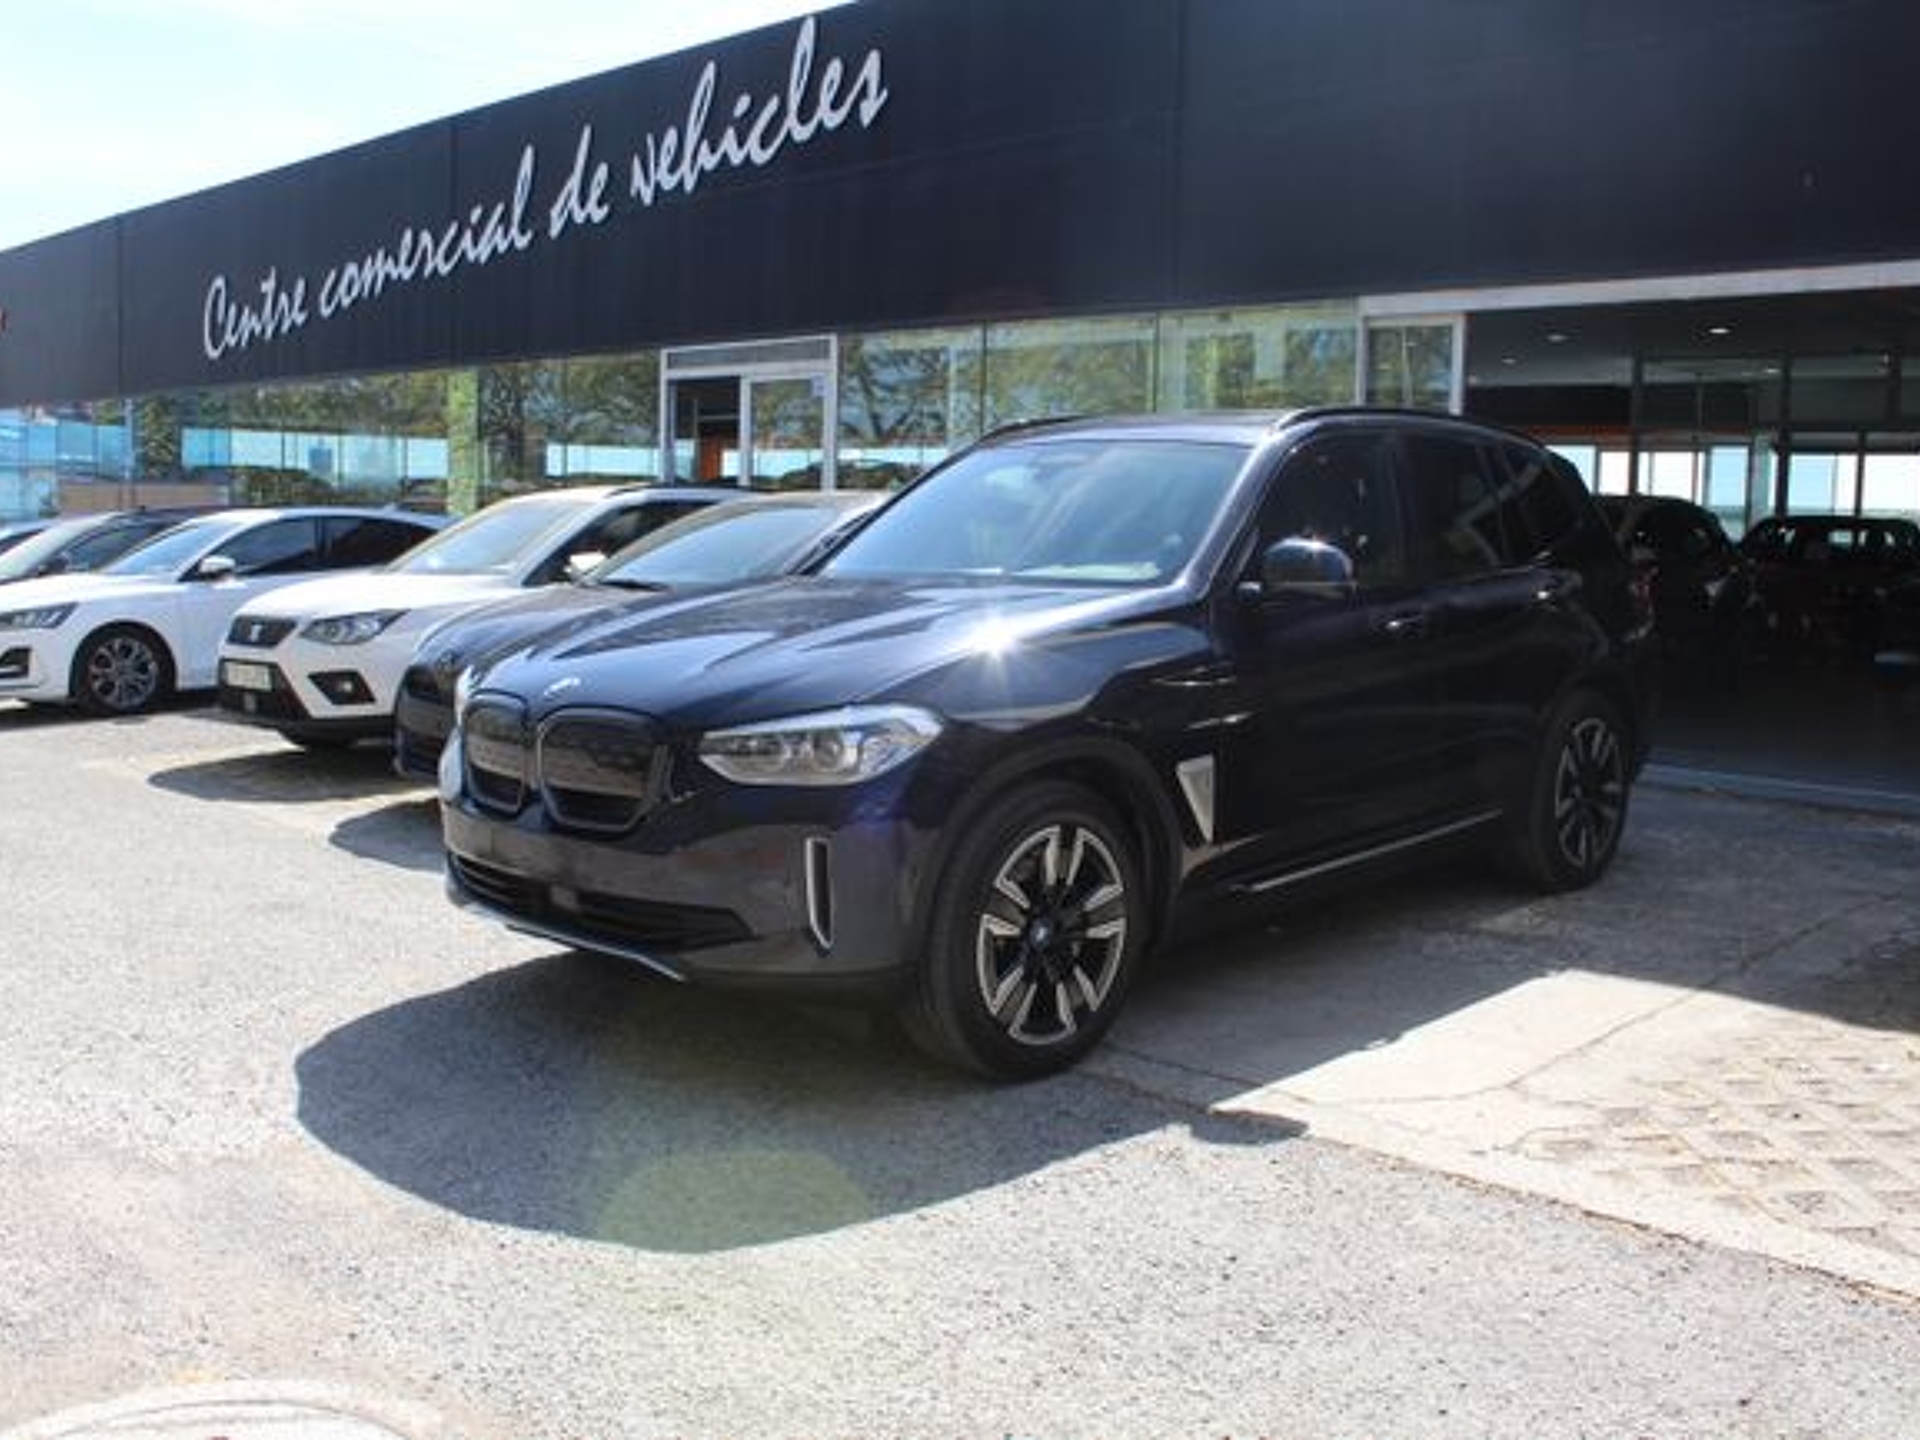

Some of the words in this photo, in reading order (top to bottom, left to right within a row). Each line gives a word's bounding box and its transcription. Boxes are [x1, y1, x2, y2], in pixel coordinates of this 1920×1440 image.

[203, 267, 307, 360] Centre
[318, 144, 533, 320] comercial
[549, 123, 610, 239] de
[630, 15, 889, 206] vehicles
